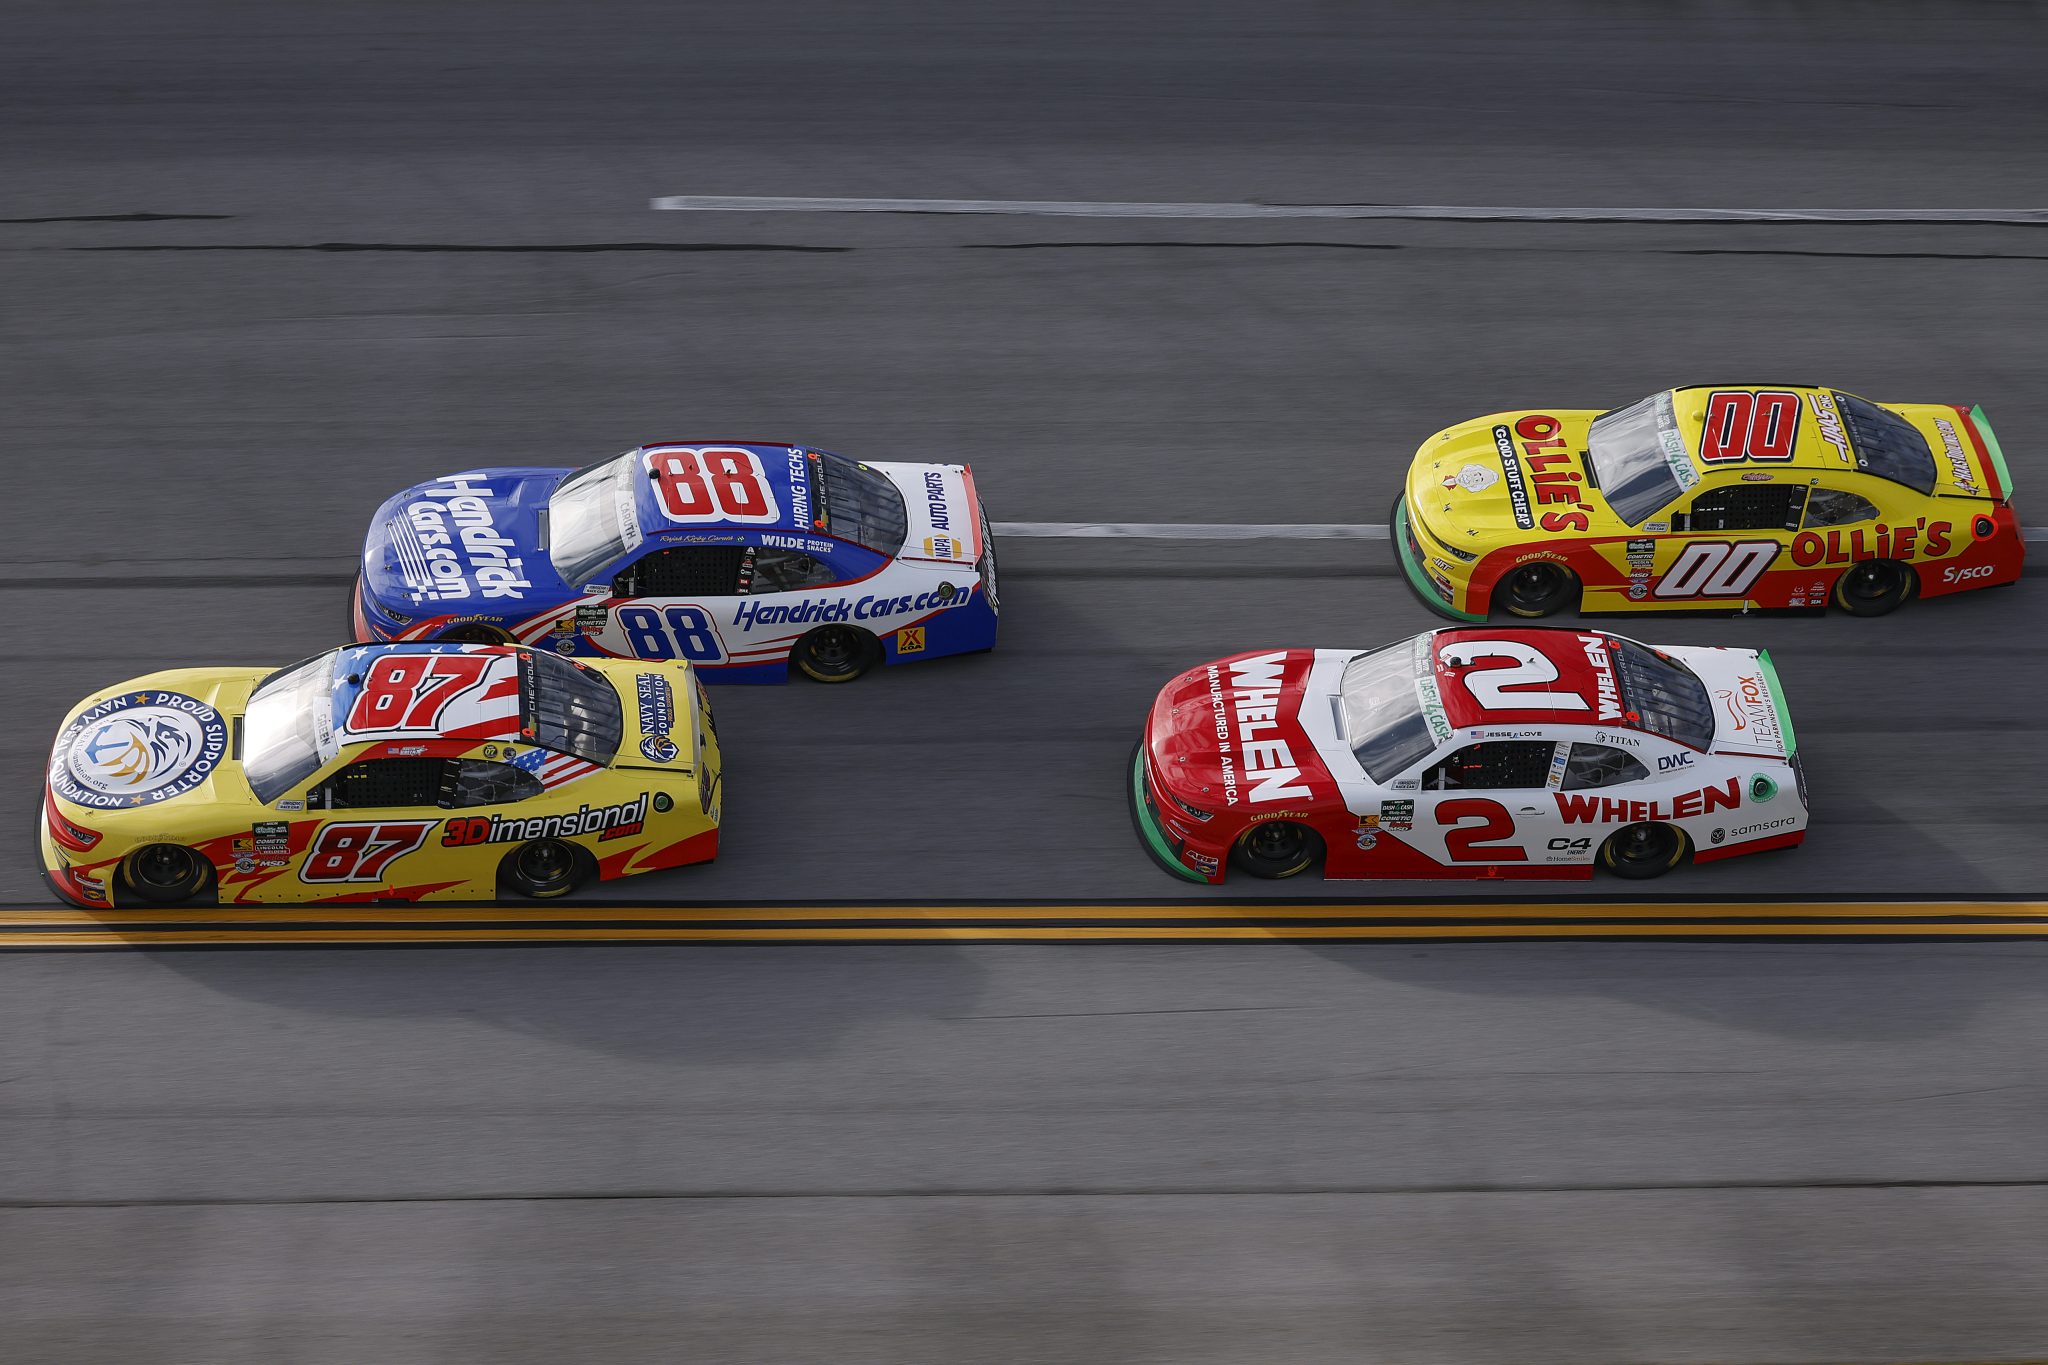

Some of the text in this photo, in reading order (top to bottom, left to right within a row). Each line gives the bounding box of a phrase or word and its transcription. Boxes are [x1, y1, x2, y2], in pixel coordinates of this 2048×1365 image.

[1663, 431, 1680, 454] DASH
[1700, 391, 1800, 463] 00
[645, 449, 779, 522] 88
[788, 448, 809, 529] HIRING TECHS
[1504, 459, 1522, 490] STUFF
[620, 502, 637, 540] CARUTH
[923, 472, 949, 531] AUTO PARTS
[407, 501, 471, 599] Cars.com
[424, 473, 532, 599] Hendrick
[761, 534, 805, 549] WILDE
[807, 545, 832, 553] SNACKS
[934, 538, 951, 558] NAPA
[1515, 551, 1568, 563] GOODYEAR
[1655, 544, 1778, 597] 00
[447, 613, 503, 624] GOODYEAR
[621, 607, 727, 661] 88
[346, 653, 499, 733] 87
[1420, 679, 1437, 702] DASH
[1440, 641, 1591, 710] 2
[1577, 635, 1623, 721] WHELEN
[1611, 639, 1634, 697] CHEVROL
[82, 697, 127, 724] NAVY
[638, 673, 655, 733] NAVY SEAL
[654, 674, 668, 735] FOUNDATION
[1229, 651, 1313, 803] WHELEN
[1423, 703, 1443, 716] 4
[1756, 671, 1785, 753] FOR PARKINSON'S RESEARCH
[150, 693, 223, 801] PROUD SUPPORTER
[318, 713, 331, 747] GREEN
[1207, 665, 1239, 807] MANUFACTURED IN AMERICA
[1608, 735, 1641, 747] TITAN
[1657, 751, 1694, 770] DWC
[443, 794, 647, 846] 3Dimensional
[1250, 810, 1309, 821] GOODYEAR
[1553, 777, 1741, 824] WHELEN
[1731, 817, 1795, 837] samsara
[300, 821, 440, 884] 87
[1434, 798, 1528, 862] 2
[1547, 838, 1592, 850] C4
